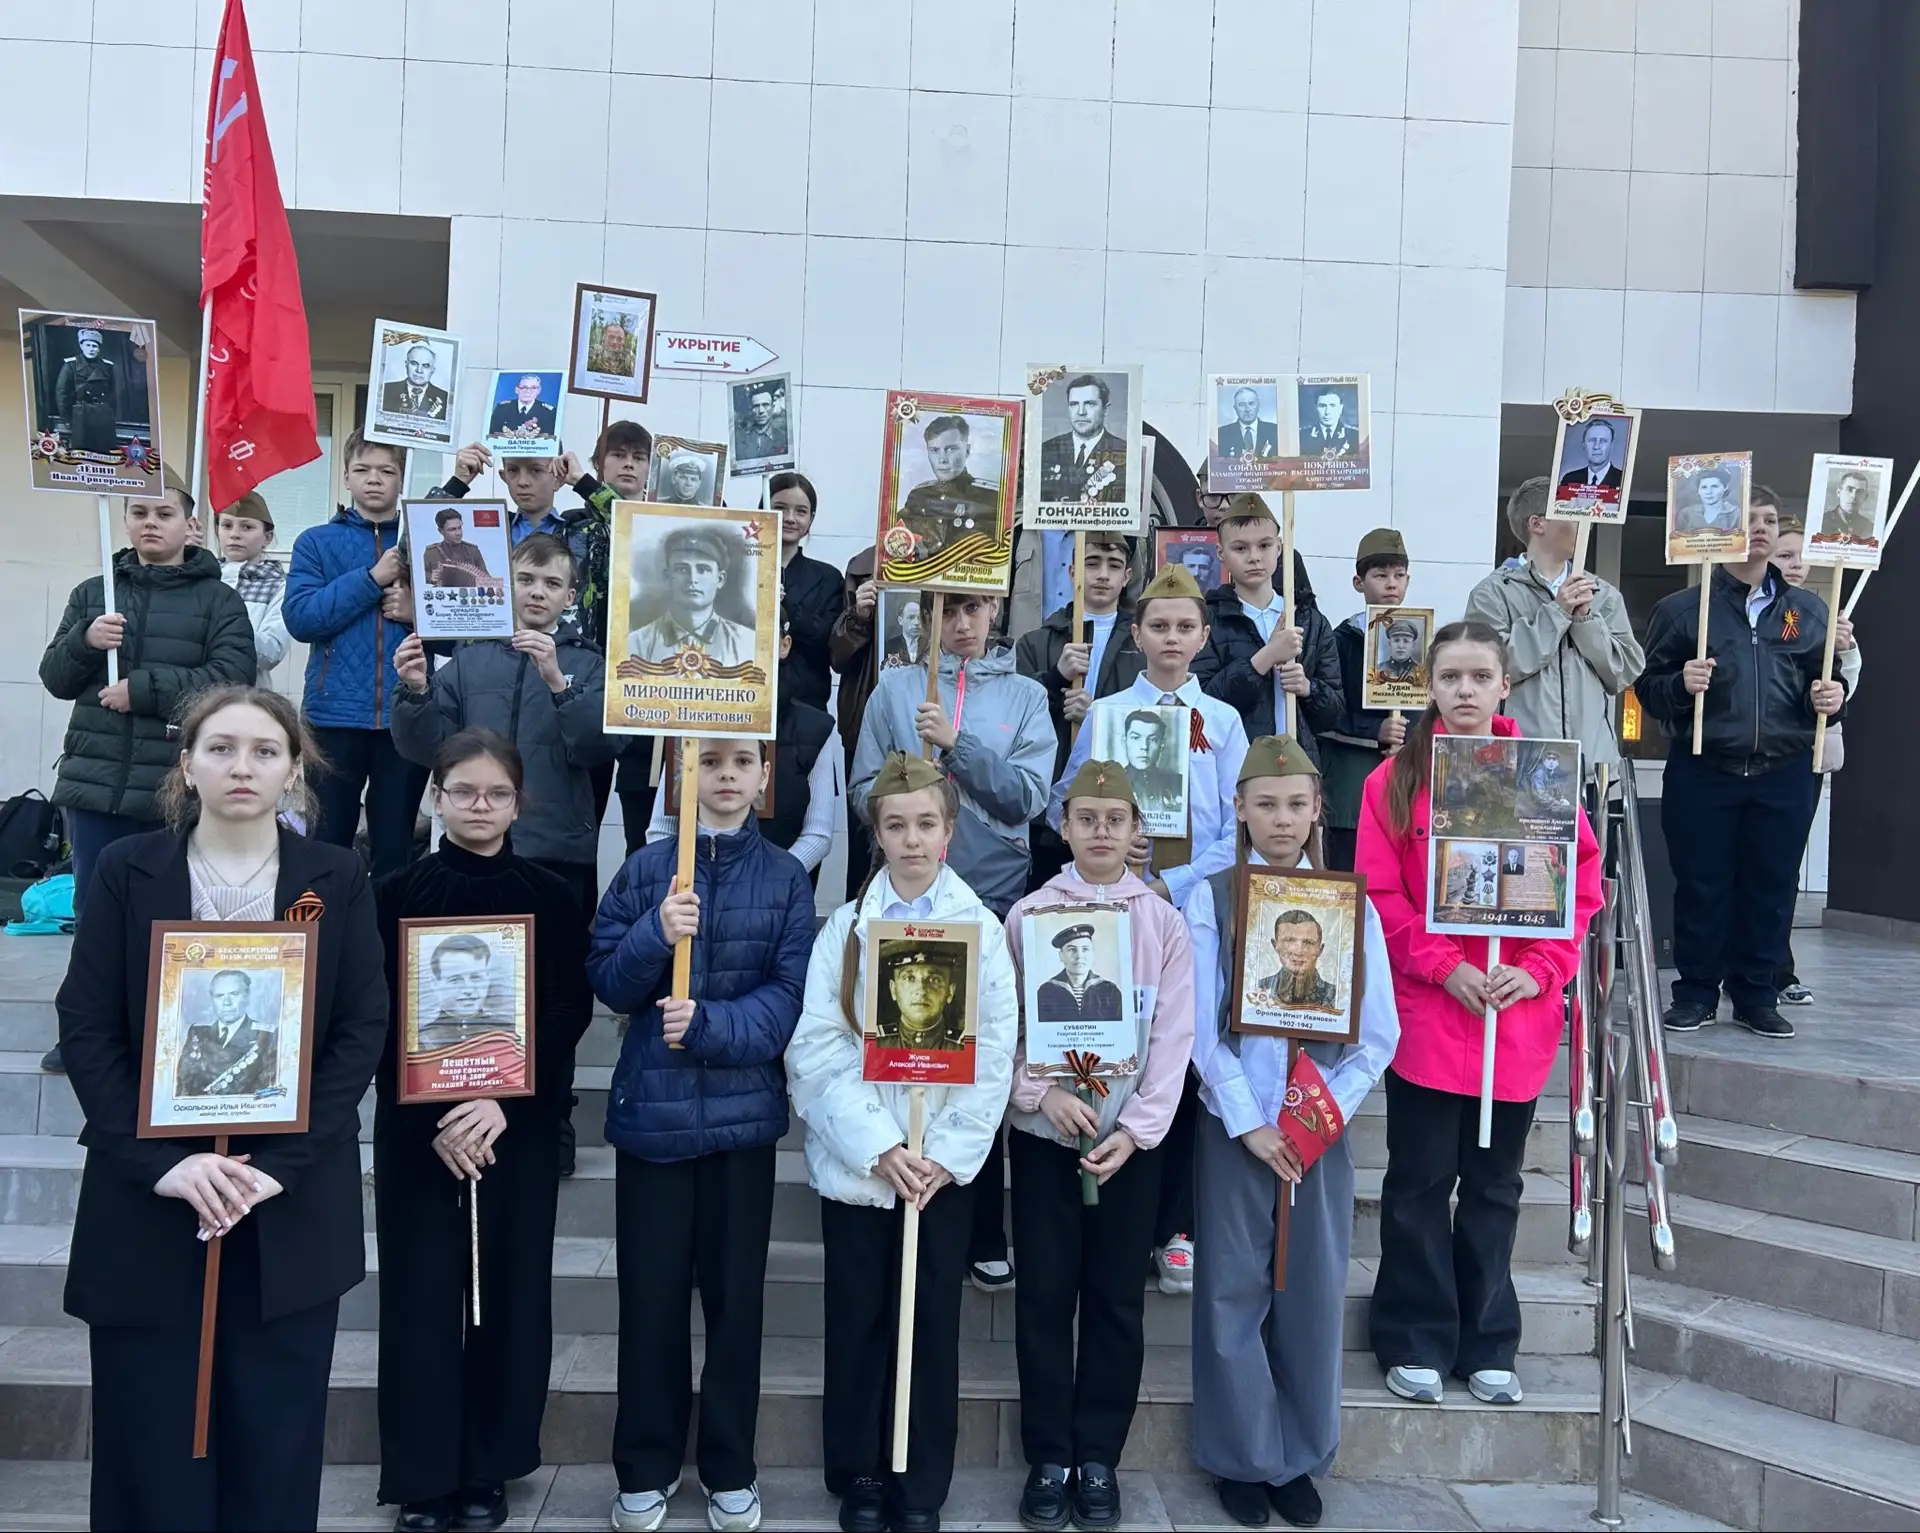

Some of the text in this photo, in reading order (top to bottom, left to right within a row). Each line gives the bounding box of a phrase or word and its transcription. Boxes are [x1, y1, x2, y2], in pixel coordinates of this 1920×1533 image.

[667, 337, 741, 353] УКРЫТИЕ
[1228, 463, 1269, 472] СОБОЛЕВ
[52, 472, 144, 486] Иван Григорьевич
[1038, 507, 1130, 517] ГОНЧАРЕНКО
[1070, 518, 1133, 526] Никифорович
[954, 562, 993, 574] Бирюков
[1387, 683, 1411, 692] Зудин
[623, 684, 756, 703] МИРОШНИЧЕНКО
[625, 704, 753, 724] Федор Никитович
[1481, 911, 1507, 923] 1941
[1518, 913, 1546, 925] 1945
[218, 946, 280, 954] БЕССМЕРТНЫЙ
[1255, 1009, 1282, 1017] Фролов
[1303, 1014, 1337, 1023] Иванович
[1279, 1020, 1313, 1029] 1902-1942
[908, 1053, 930, 1062] Жуков
[888, 1060, 950, 1069] Алексей Иванович
[1307, 1083, 1338, 1136] 9 МАЯ
